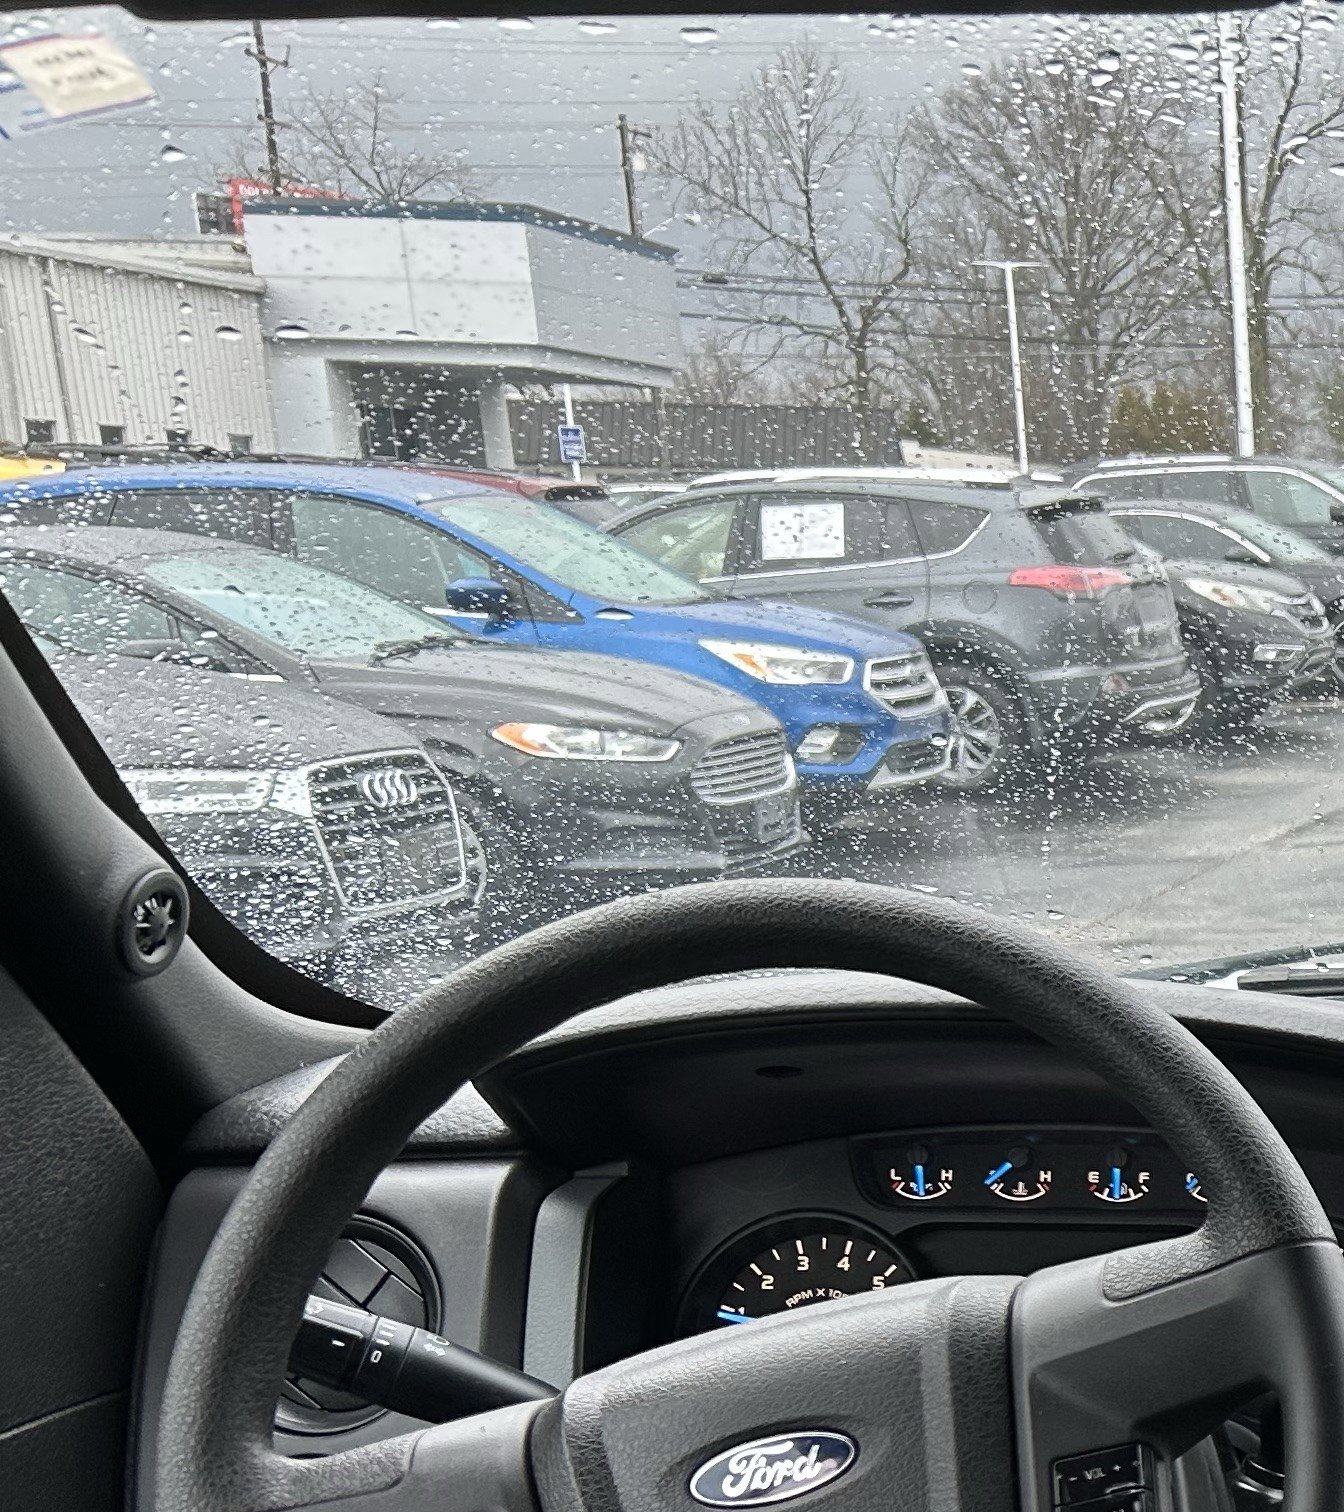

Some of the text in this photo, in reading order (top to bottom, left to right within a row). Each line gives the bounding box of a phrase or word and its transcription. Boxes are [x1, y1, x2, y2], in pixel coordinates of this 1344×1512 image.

[890, 1168, 902, 1180] L
[940, 1168, 953, 1181] H
[1039, 1170, 1052, 1183] H
[1087, 1171, 1100, 1184] E
[1138, 1171, 1150, 1184] F
[796, 1255, 810, 1271] 3
[836, 1256, 851, 1272] 4
[760, 1274, 775, 1290] 2
[871, 1275, 886, 1291] 5
[785, 1291, 814, 1308] RPM
[815, 1288, 827, 1298] X
[722, 1440, 823, 1498] Ford
